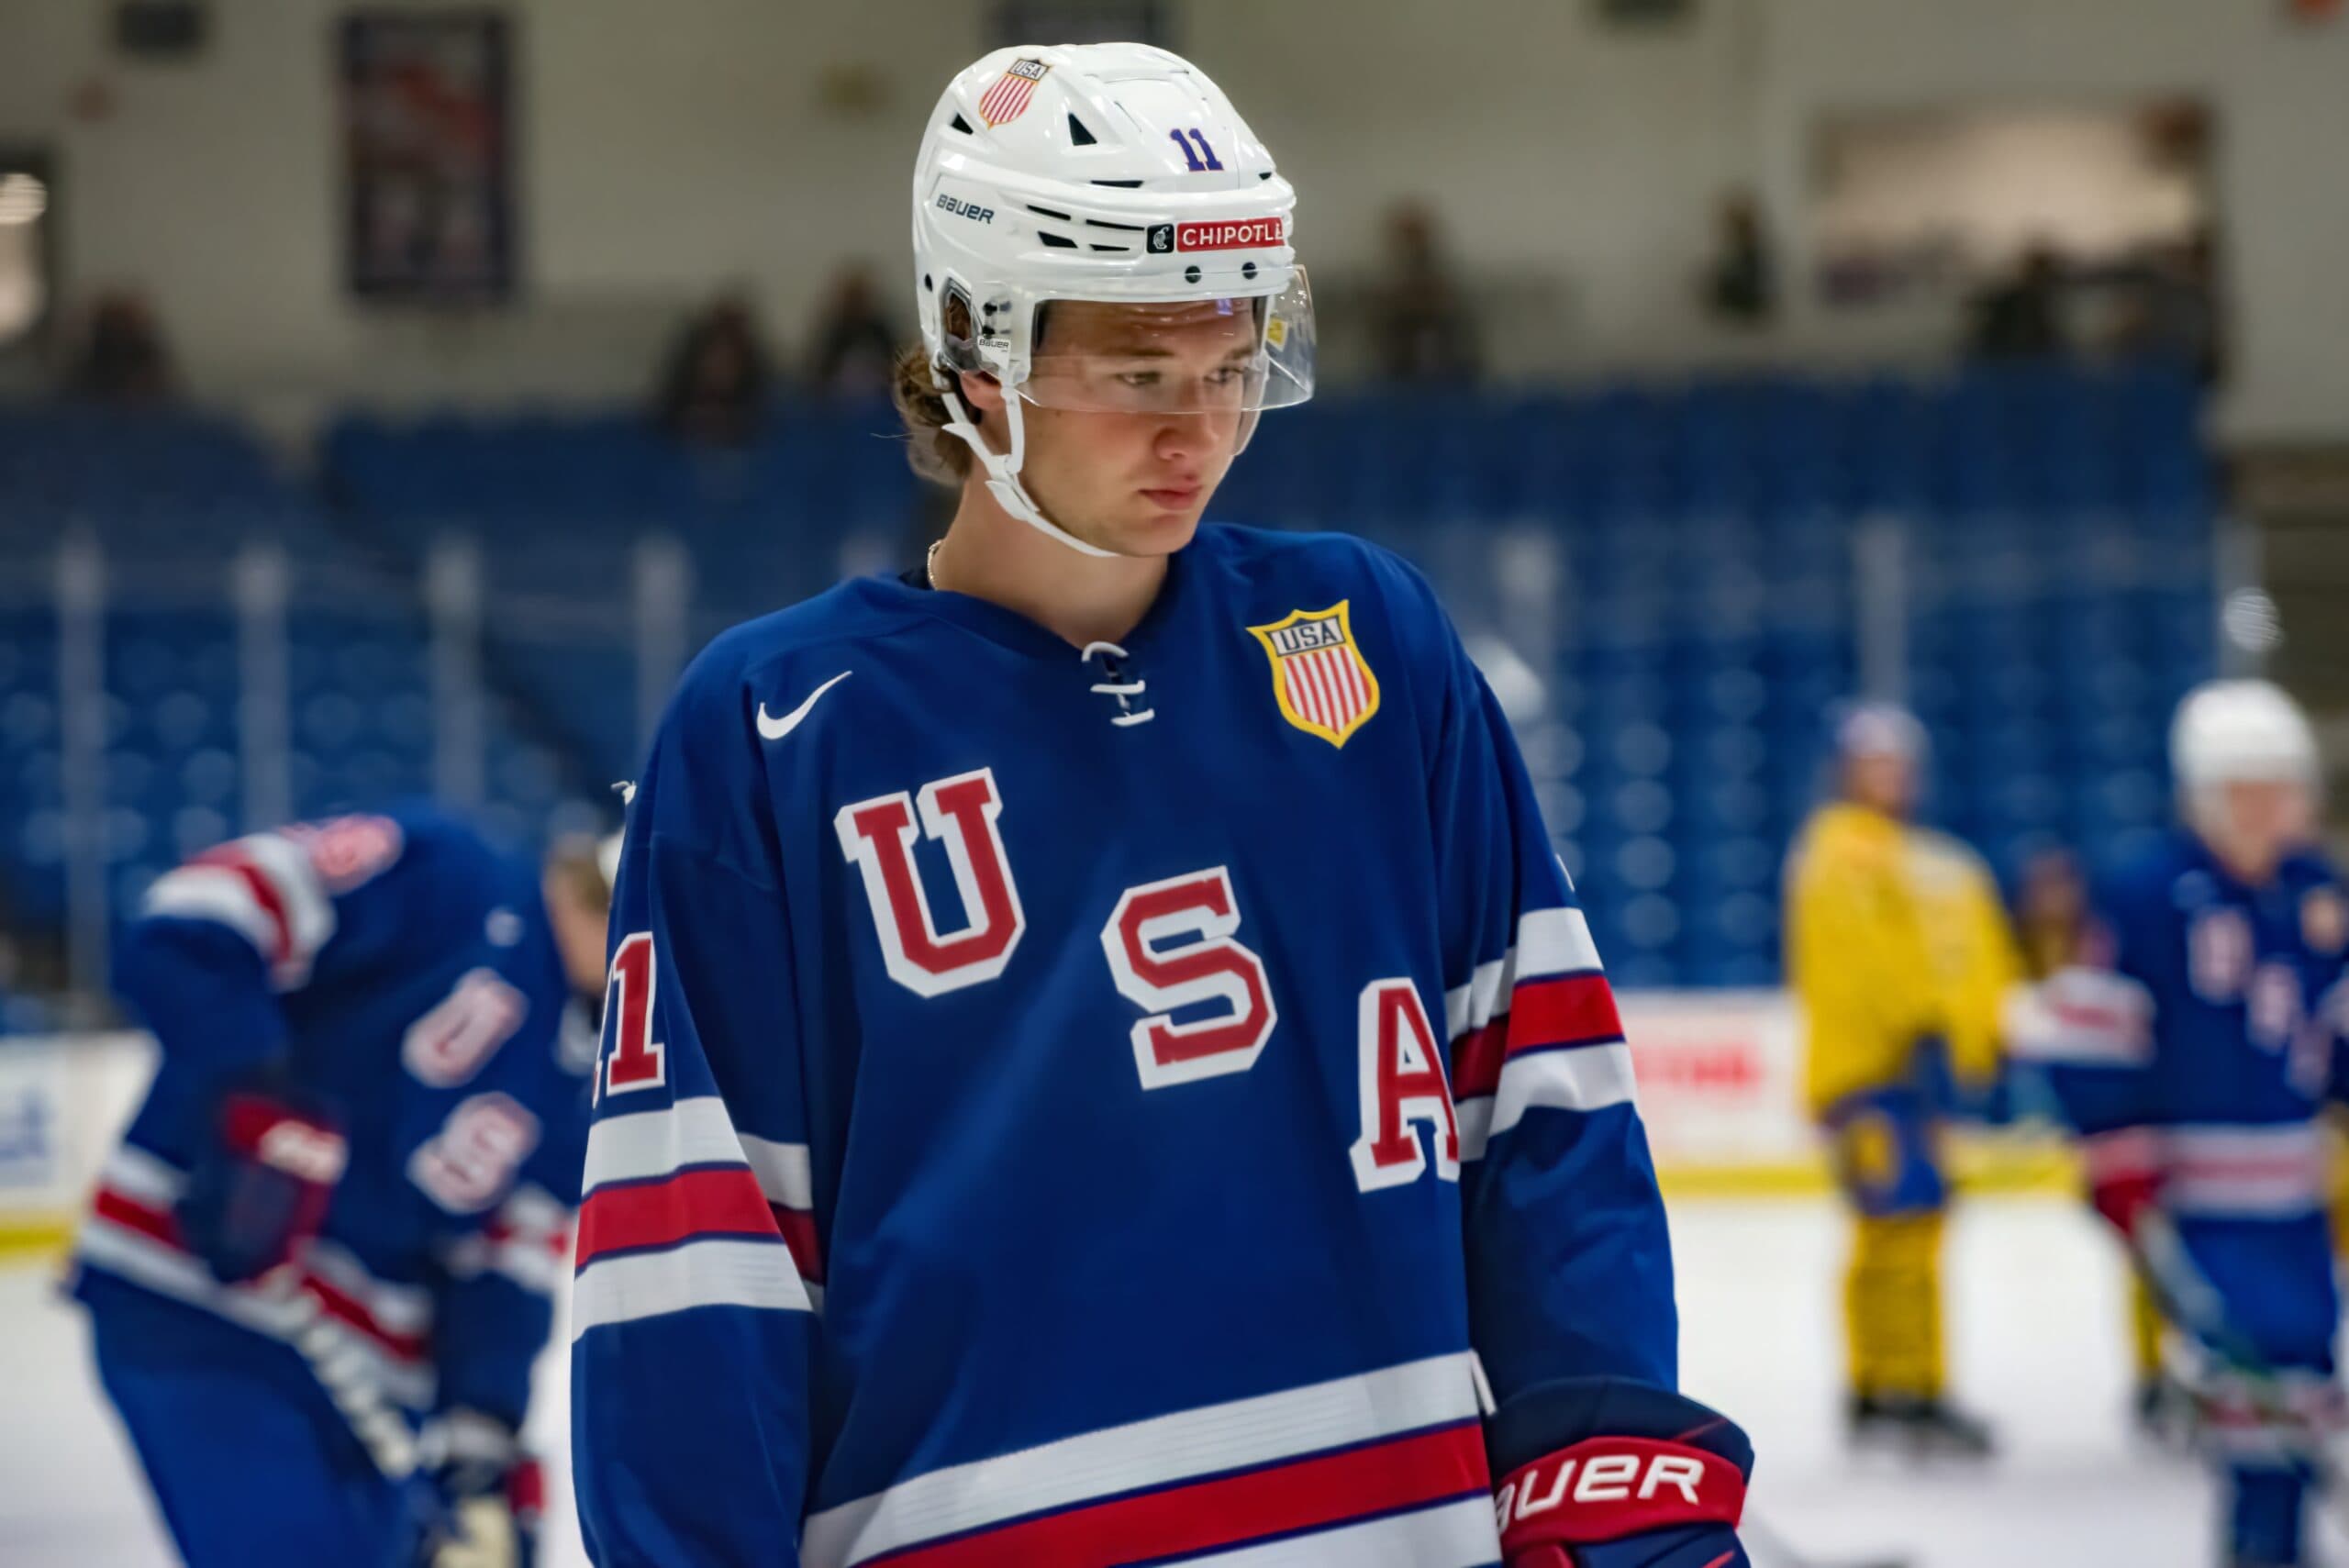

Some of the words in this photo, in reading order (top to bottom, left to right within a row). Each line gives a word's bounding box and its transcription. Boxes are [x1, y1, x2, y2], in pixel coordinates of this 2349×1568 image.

[1013, 61, 1043, 78] USA
[1169, 128, 1225, 172] 11
[1279, 620, 1339, 651] USA
[592, 930, 666, 1109] 1
